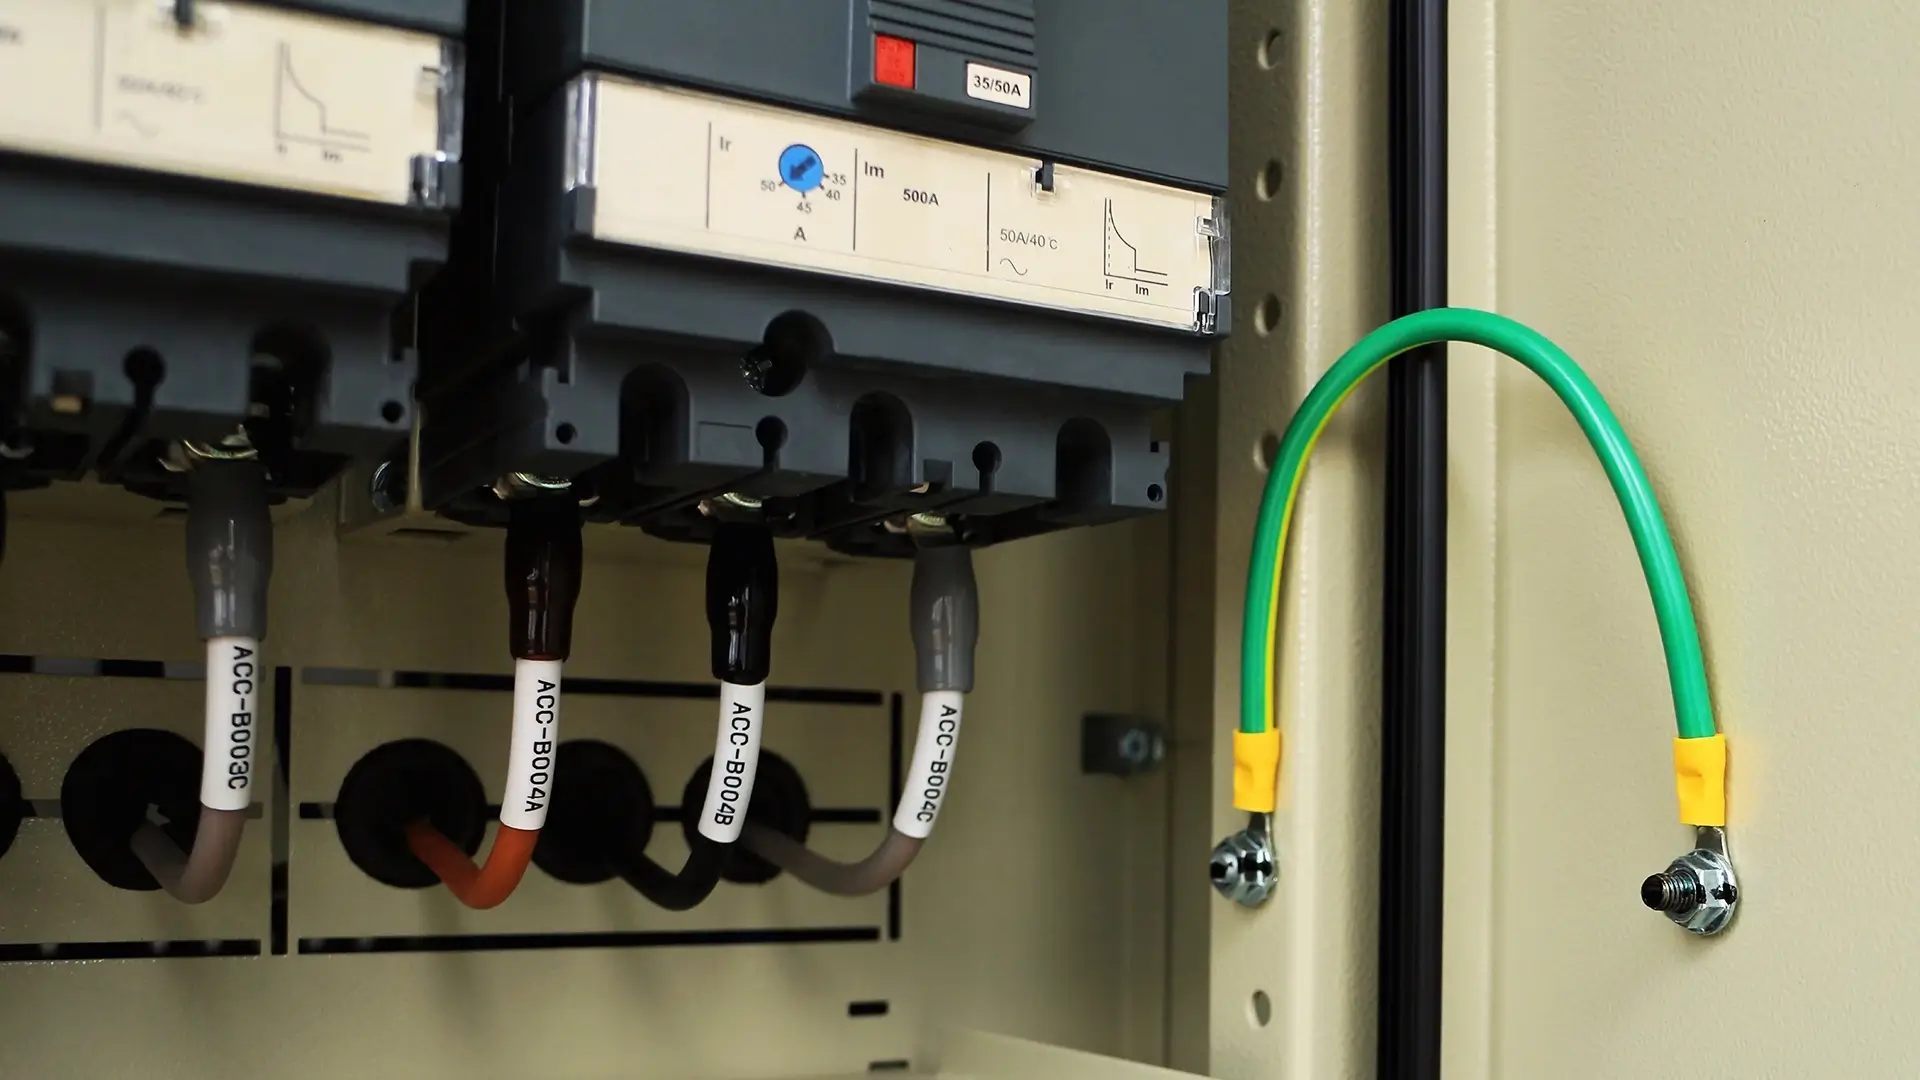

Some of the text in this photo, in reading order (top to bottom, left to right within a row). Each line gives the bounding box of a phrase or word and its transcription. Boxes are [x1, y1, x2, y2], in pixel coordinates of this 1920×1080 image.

[972, 73, 1022, 98] 35/50A
[719, 136, 732, 151] Ir
[864, 161, 885, 179] Im
[760, 179, 776, 193] 50
[831, 173, 847, 186] 35
[825, 189, 841, 202] 40
[902, 188, 940, 207] 500A
[796, 201, 812, 215] 45
[793, 226, 807, 241] A
[1105, 279, 1114, 290] Ir
[1135, 283, 1150, 296] Im
[227, 645, 254, 790] ACC-B003C
[524, 679, 556, 813] ACC-B004A
[714, 701, 752, 826] ACC-B004B
[916, 704, 957, 823] ACC-B004C
